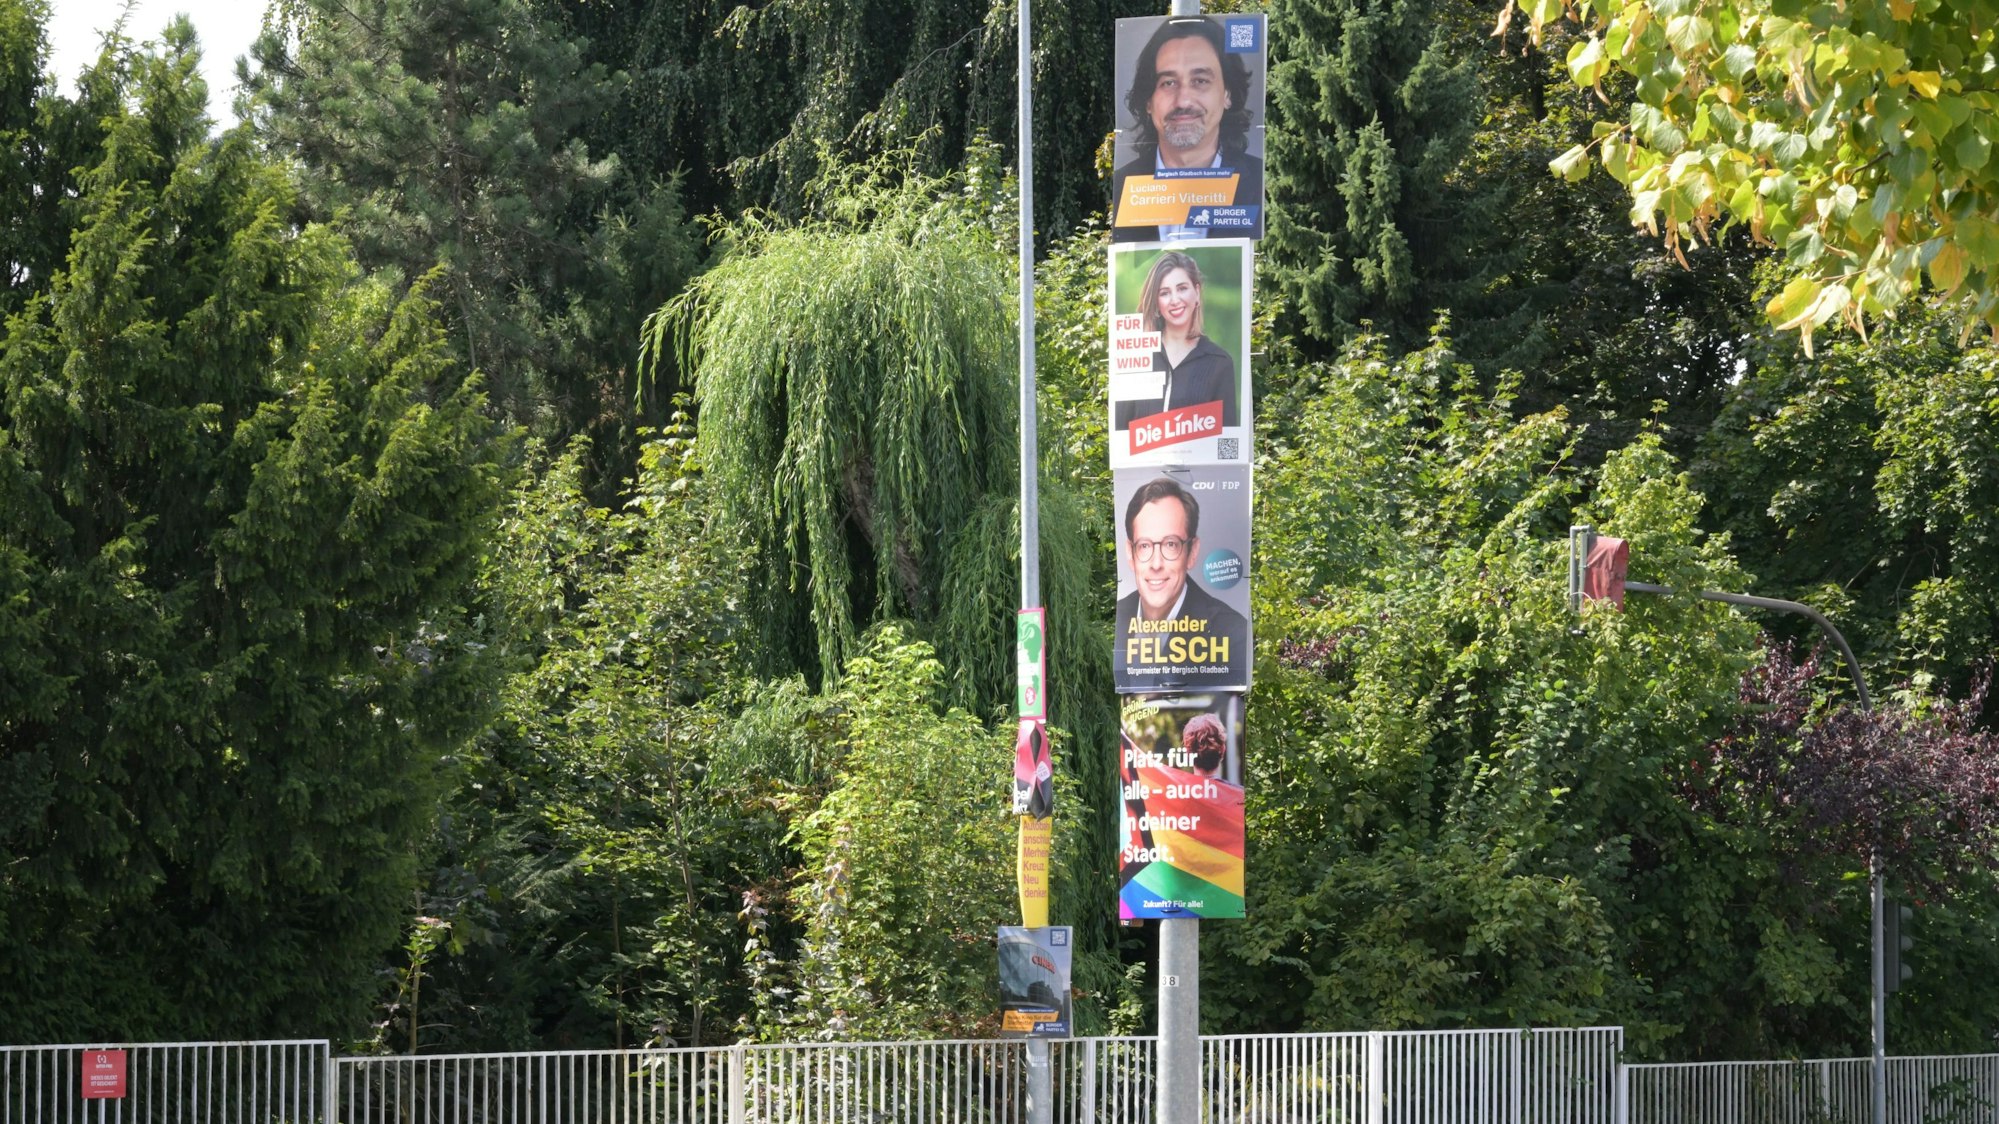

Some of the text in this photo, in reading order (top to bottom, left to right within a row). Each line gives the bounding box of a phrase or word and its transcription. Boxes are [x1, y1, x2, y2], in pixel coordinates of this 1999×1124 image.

[1130, 184, 1167, 193] Luciano
[1130, 192, 1226, 206] Carrieri Viteritti
[1116, 316, 1140, 330] FÜR
[1116, 336, 1158, 350] NEUEN
[1116, 356, 1150, 368] WIND
[1136, 424, 1162, 447] Die
[1192, 481, 1240, 490] CDU FDP
[1205, 558, 1240, 570] MACHEN,
[1128, 616, 1208, 633] Alexander
[1127, 636, 1229, 664] FELSCH
[1127, 667, 1160, 676] Bürgermeister
[1171, 666, 1198, 675] Bergisch
[1122, 698, 1146, 716] GRÜNE
[1124, 747, 1198, 768] Platz für
[1124, 780, 1150, 800] alle
[1166, 779, 1218, 799] auch
[1139, 811, 1200, 831] deiner
[1124, 842, 1175, 863] Stadt.
[1023, 861, 1044, 871] Kreuz
[1023, 874, 1039, 884] Neu
